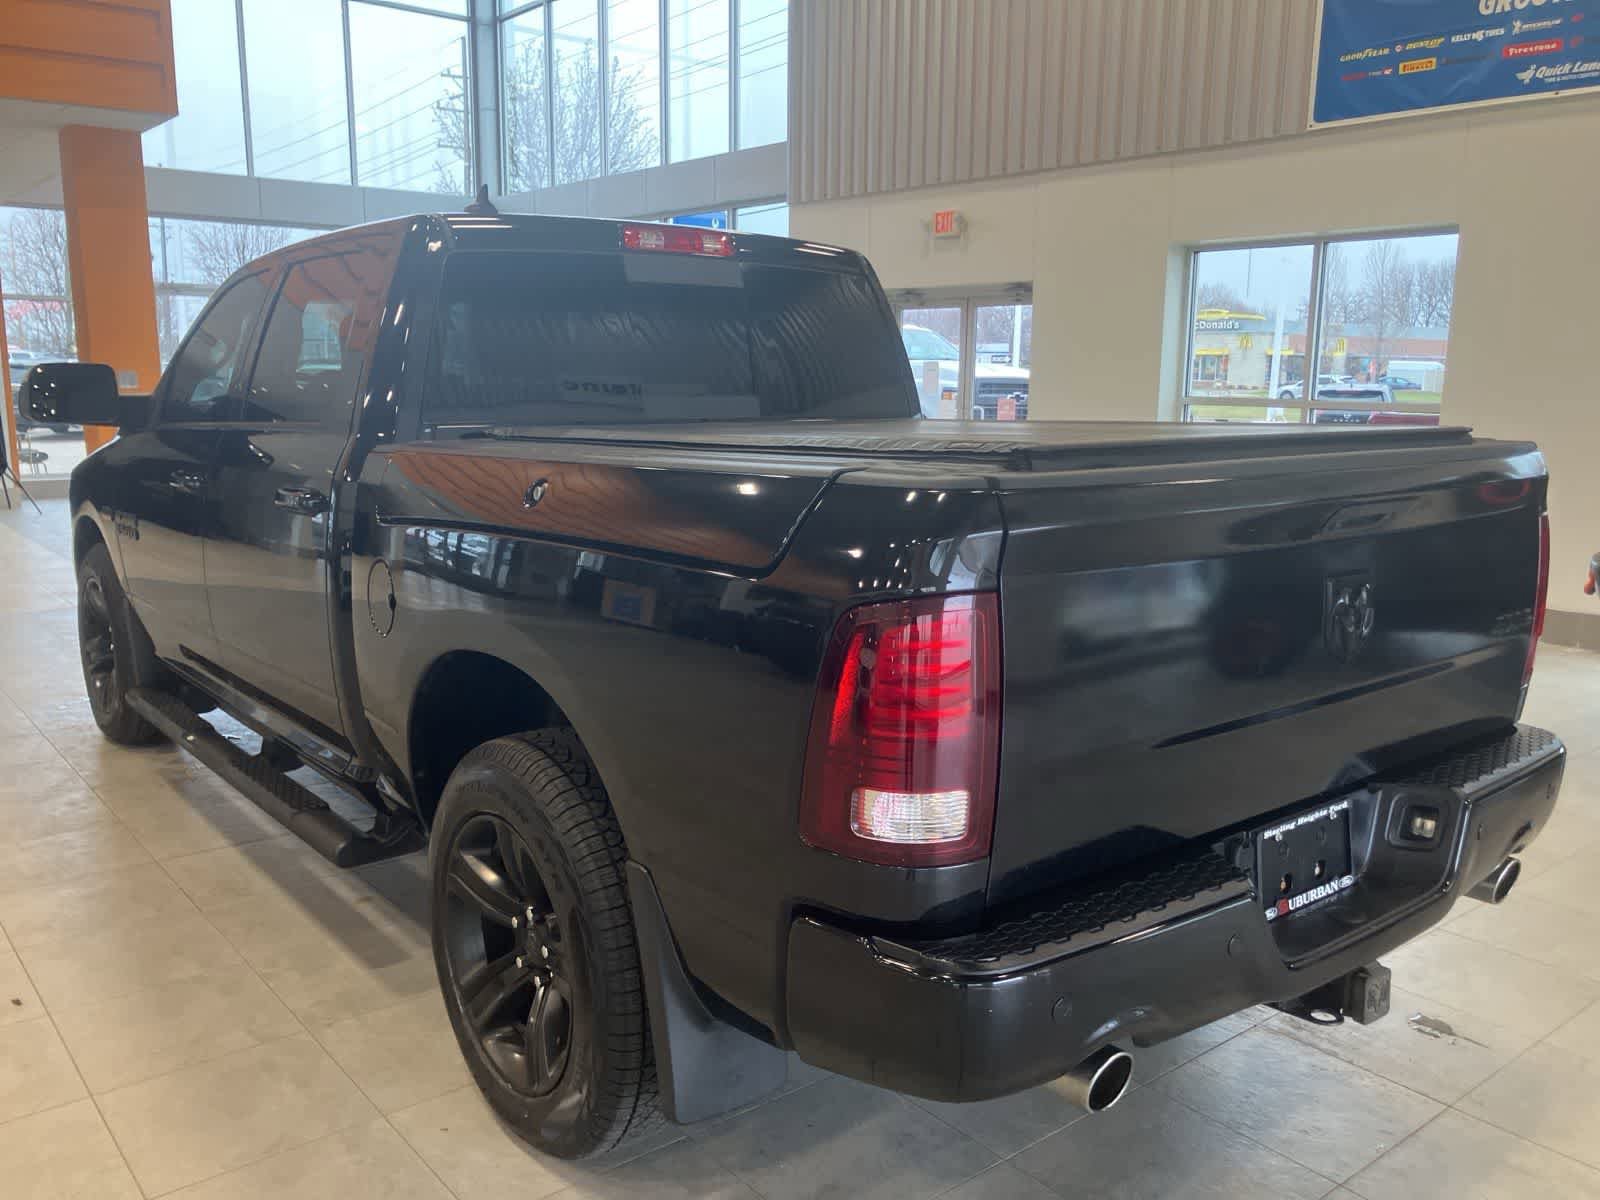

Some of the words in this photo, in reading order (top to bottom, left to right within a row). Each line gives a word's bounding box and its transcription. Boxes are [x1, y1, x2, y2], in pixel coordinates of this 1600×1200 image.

[1450, 32, 1473, 43] KELLY
[1535, 61, 1572, 79] Quick
[935, 211, 953, 233] EXIT
[1195, 320, 1240, 329] cDonald's
